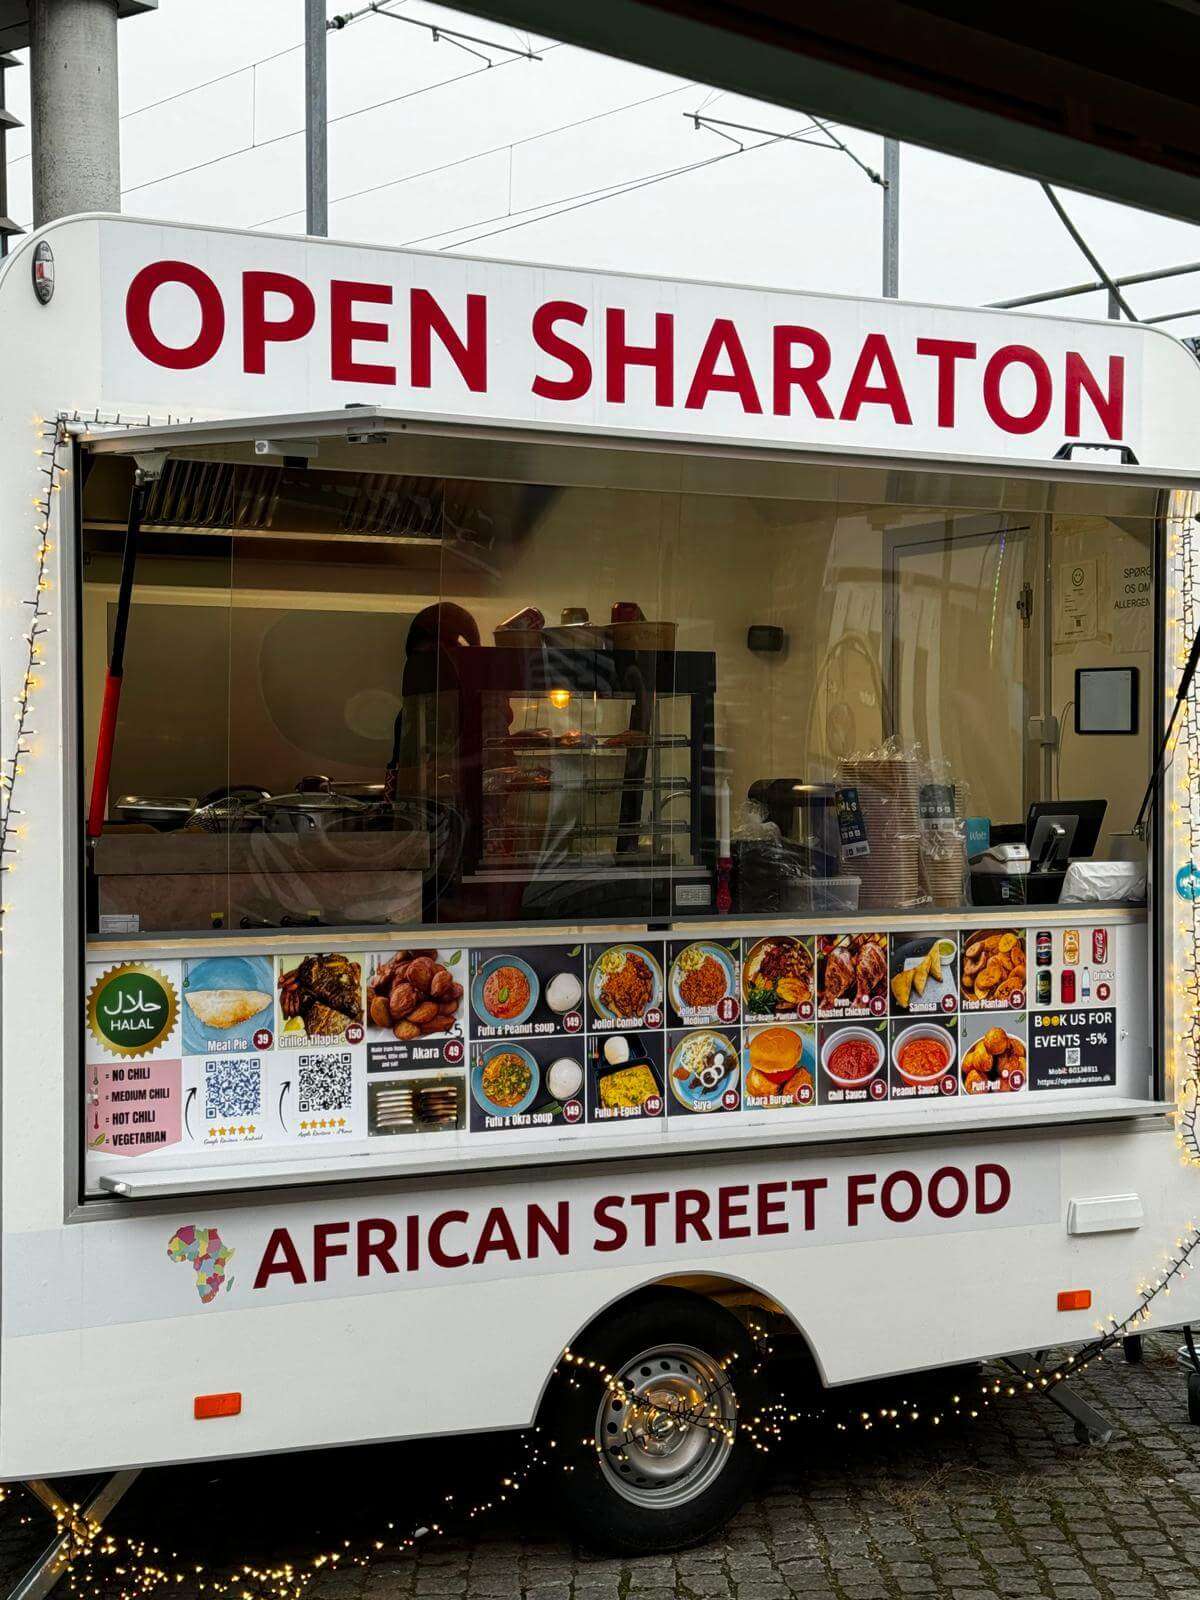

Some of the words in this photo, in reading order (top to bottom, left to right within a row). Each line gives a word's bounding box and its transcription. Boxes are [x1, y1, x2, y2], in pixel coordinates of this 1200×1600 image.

[126, 260, 487, 393] OPEN
[531, 300, 1124, 441] SHARATON
[1125, 584, 1136, 593] OS
[104, 990, 161, 1015] حلال
[909, 1002, 937, 1012] Samosa
[962, 999, 980, 1010] Fried
[981, 998, 1008, 1009] Plantain
[818, 1007, 844, 1018] Roasted
[845, 1006, 870, 1016] Chicken
[110, 1018, 154, 1031] HALAL
[566, 1016, 579, 1027] 149
[592, 1018, 614, 1030] Jollof
[616, 1016, 643, 1028] Combo
[1034, 1014, 1068, 1028] BOOK
[1070, 1013, 1086, 1026] US
[1088, 1012, 1112, 1025] FOR
[347, 1028, 362, 1040] 150
[478, 1026, 496, 1036] Fufu
[505, 1023, 532, 1034] Peanut
[534, 1022, 555, 1034] soup
[208, 1040, 232, 1052] Meat
[234, 1038, 248, 1050] Pie
[257, 1034, 268, 1044] 39
[278, 1034, 308, 1048] Grilled
[310, 1033, 339, 1047] Tilapia
[1034, 1034, 1080, 1048] EVENTS
[1086, 1032, 1108, 1045] -5%
[412, 1047, 440, 1060] Akara
[448, 1046, 460, 1056] 49
[112, 1069, 124, 1082] NO
[128, 1067, 150, 1080] CHILI
[892, 1086, 916, 1096] Peanut
[918, 1085, 939, 1095] Sauce
[972, 1080, 1000, 1091] Puff-Puff
[112, 1089, 146, 1102] MEDIUM
[149, 1088, 170, 1100] CHILI
[747, 1095, 768, 1106] Akara
[770, 1094, 794, 1106] Burger
[828, 1090, 844, 1100] Chili
[845, 1090, 866, 1100] Sauce
[566, 1106, 579, 1116] 149
[594, 1106, 611, 1118] Fufu
[620, 1104, 642, 1117] Egusi
[647, 1100, 660, 1110] 149
[694, 1100, 712, 1110] Suya
[112, 1112, 130, 1126] HOT
[132, 1110, 156, 1123] CHILI
[485, 1116, 502, 1128] Fufu
[512, 1114, 530, 1126] Okra
[532, 1112, 553, 1124] soup
[112, 1131, 166, 1146] VEGETARIAN
[252, 1201, 570, 1290] AFRICAN
[593, 1177, 828, 1252] STREET
[847, 1163, 1011, 1226] FOOD
